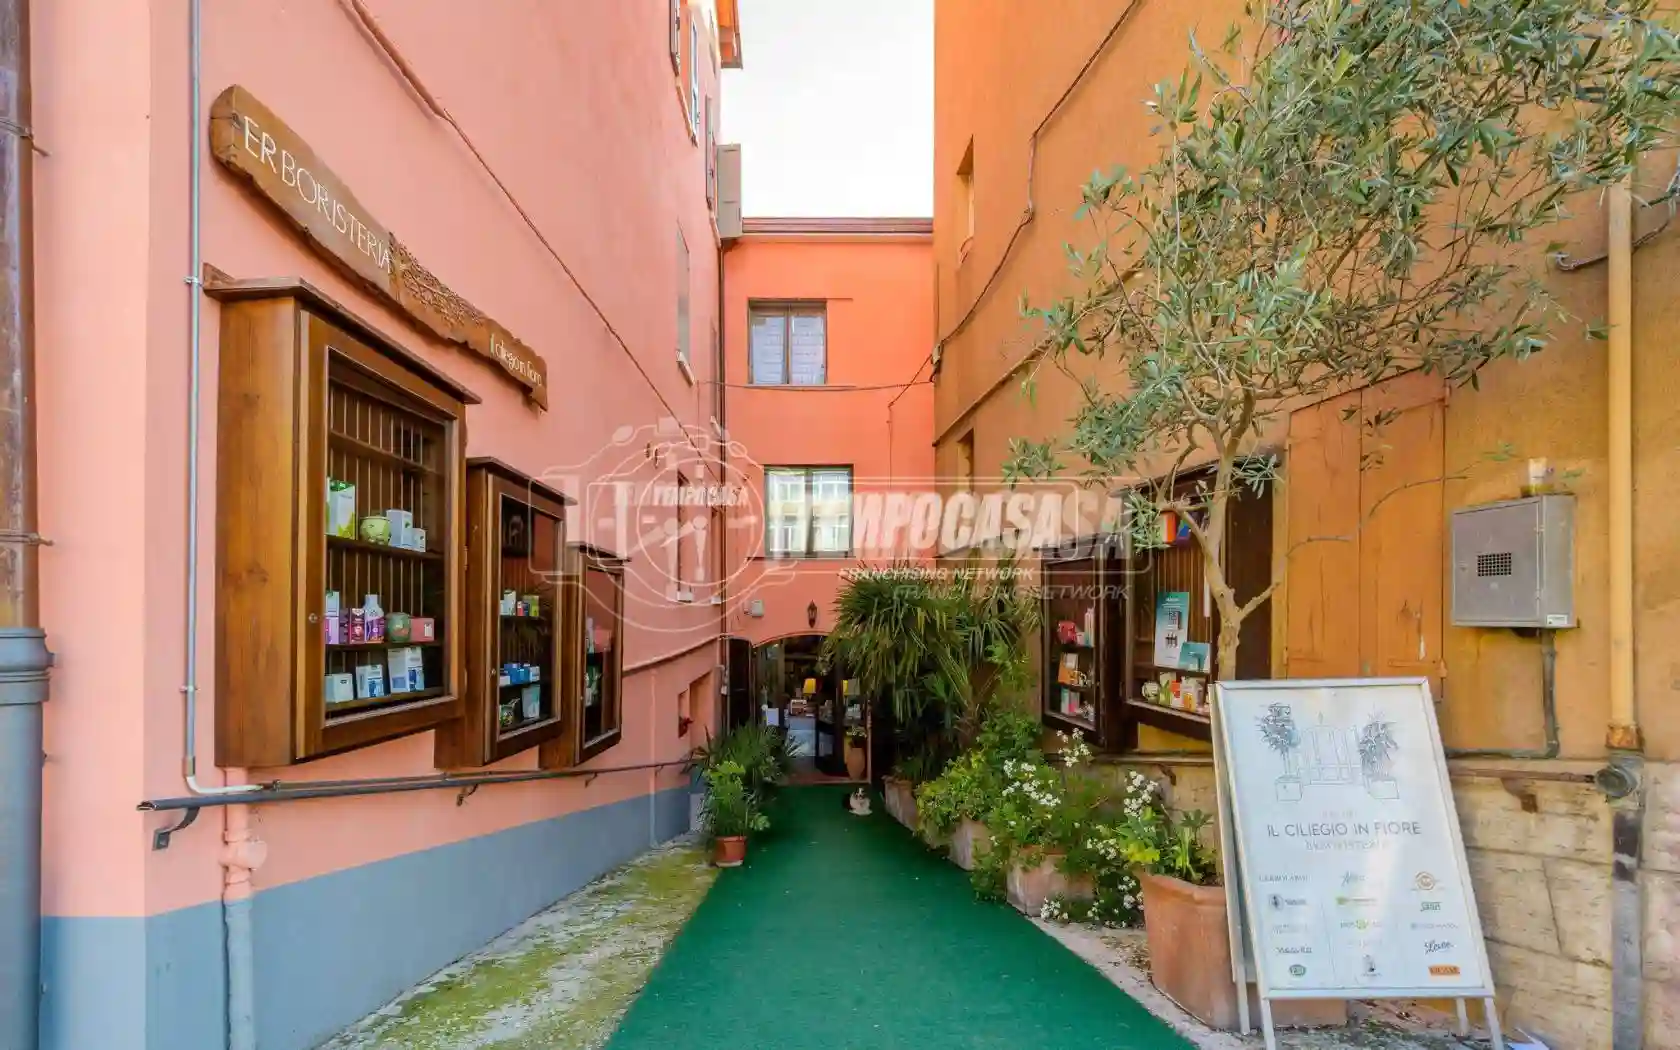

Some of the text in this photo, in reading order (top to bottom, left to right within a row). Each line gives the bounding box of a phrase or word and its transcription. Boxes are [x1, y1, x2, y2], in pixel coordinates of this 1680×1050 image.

[243, 115, 393, 275] ERBORISTERIA
[1284, 823, 1349, 837] CILIEGIO
[1353, 822, 1371, 836] IN
[1374, 821, 1422, 835] FIORE
